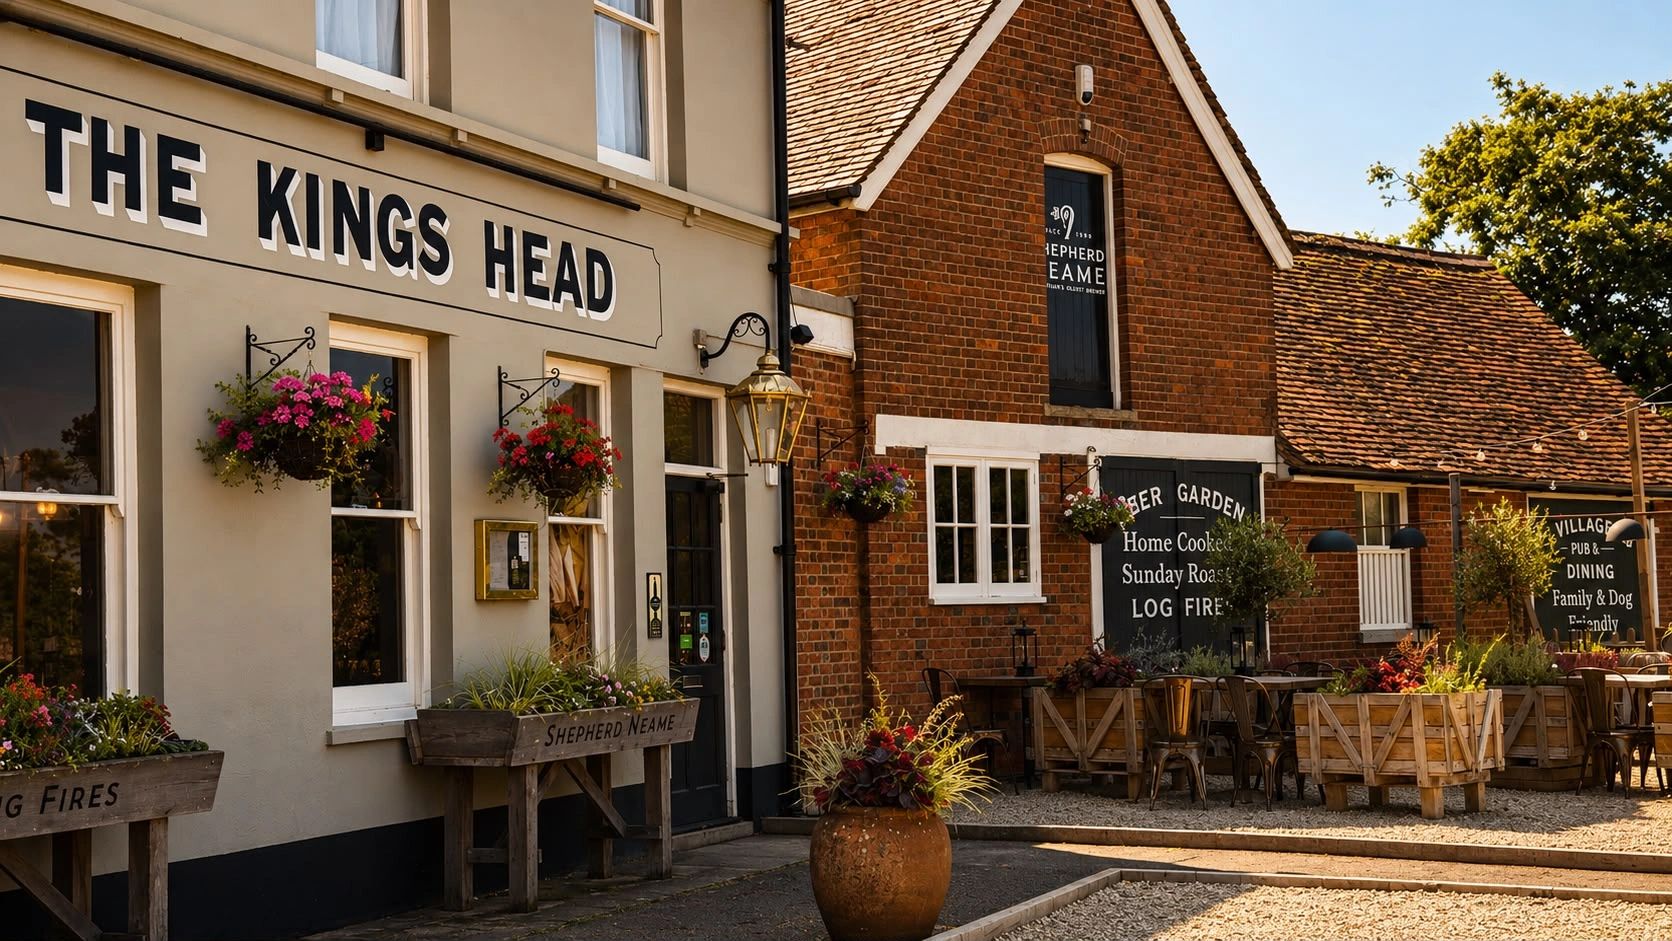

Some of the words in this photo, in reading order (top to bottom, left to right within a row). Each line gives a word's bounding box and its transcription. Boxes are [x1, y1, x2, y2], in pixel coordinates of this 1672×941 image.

[25, 99, 207, 236] THE
[257, 160, 453, 286] KINGS
[484, 220, 617, 321] HEAD
[1177, 483, 1245, 522] GARDEN
[1555, 518, 1613, 538] VILLAGE
[1123, 531, 1172, 552] Home
[1571, 542, 1591, 555] PUB
[1592, 542, 1600, 555] &
[1122, 562, 1184, 590] Sunday
[1567, 564, 1615, 579] DINING
[1132, 598, 1173, 618] LOG
[1185, 597, 1233, 616] FIRE
[1552, 588, 1593, 610] Family
[1596, 589, 1606, 606] &
[1608, 588, 1633, 610] Dog
[39, 782, 120, 815] FIRES
